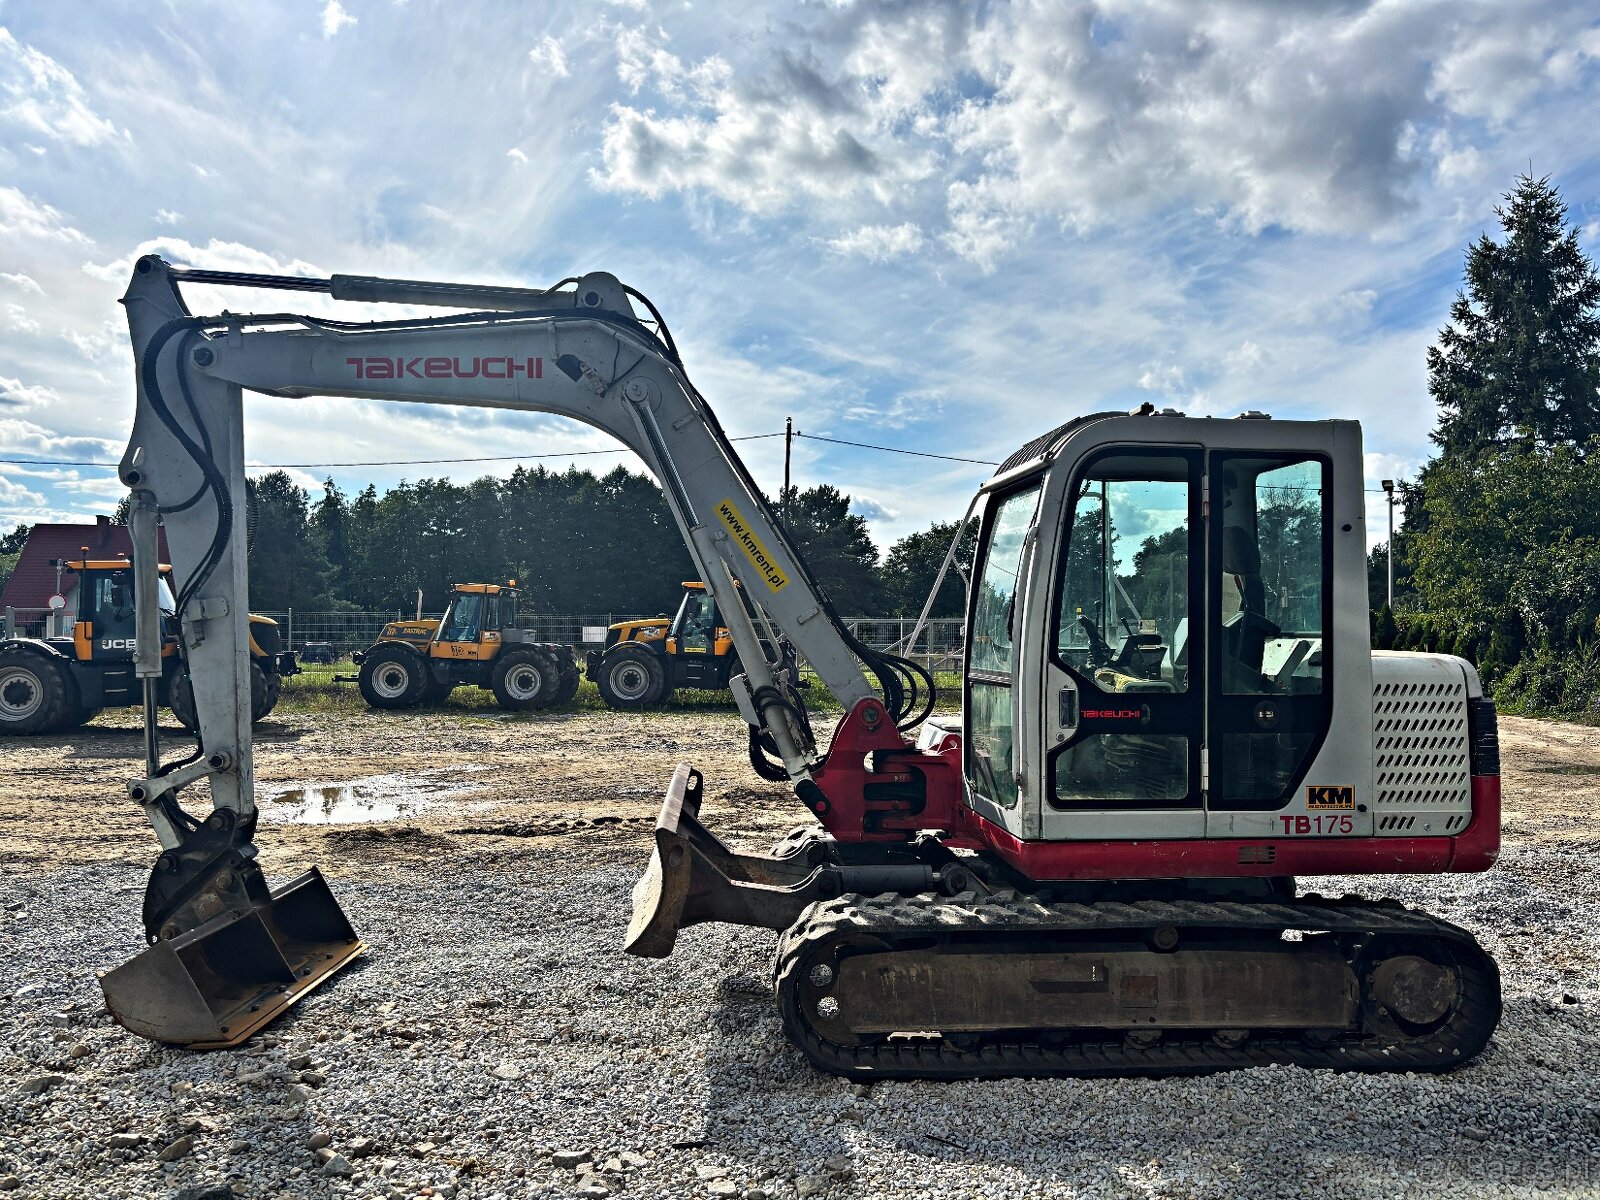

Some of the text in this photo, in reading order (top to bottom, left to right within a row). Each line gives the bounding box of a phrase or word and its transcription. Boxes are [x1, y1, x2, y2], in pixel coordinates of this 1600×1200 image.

[720, 504, 785, 588] www.kmrent.pl
[101, 639, 137, 649] JCB
[1308, 788, 1353, 804] KM
[1280, 815, 1354, 834] TB175
